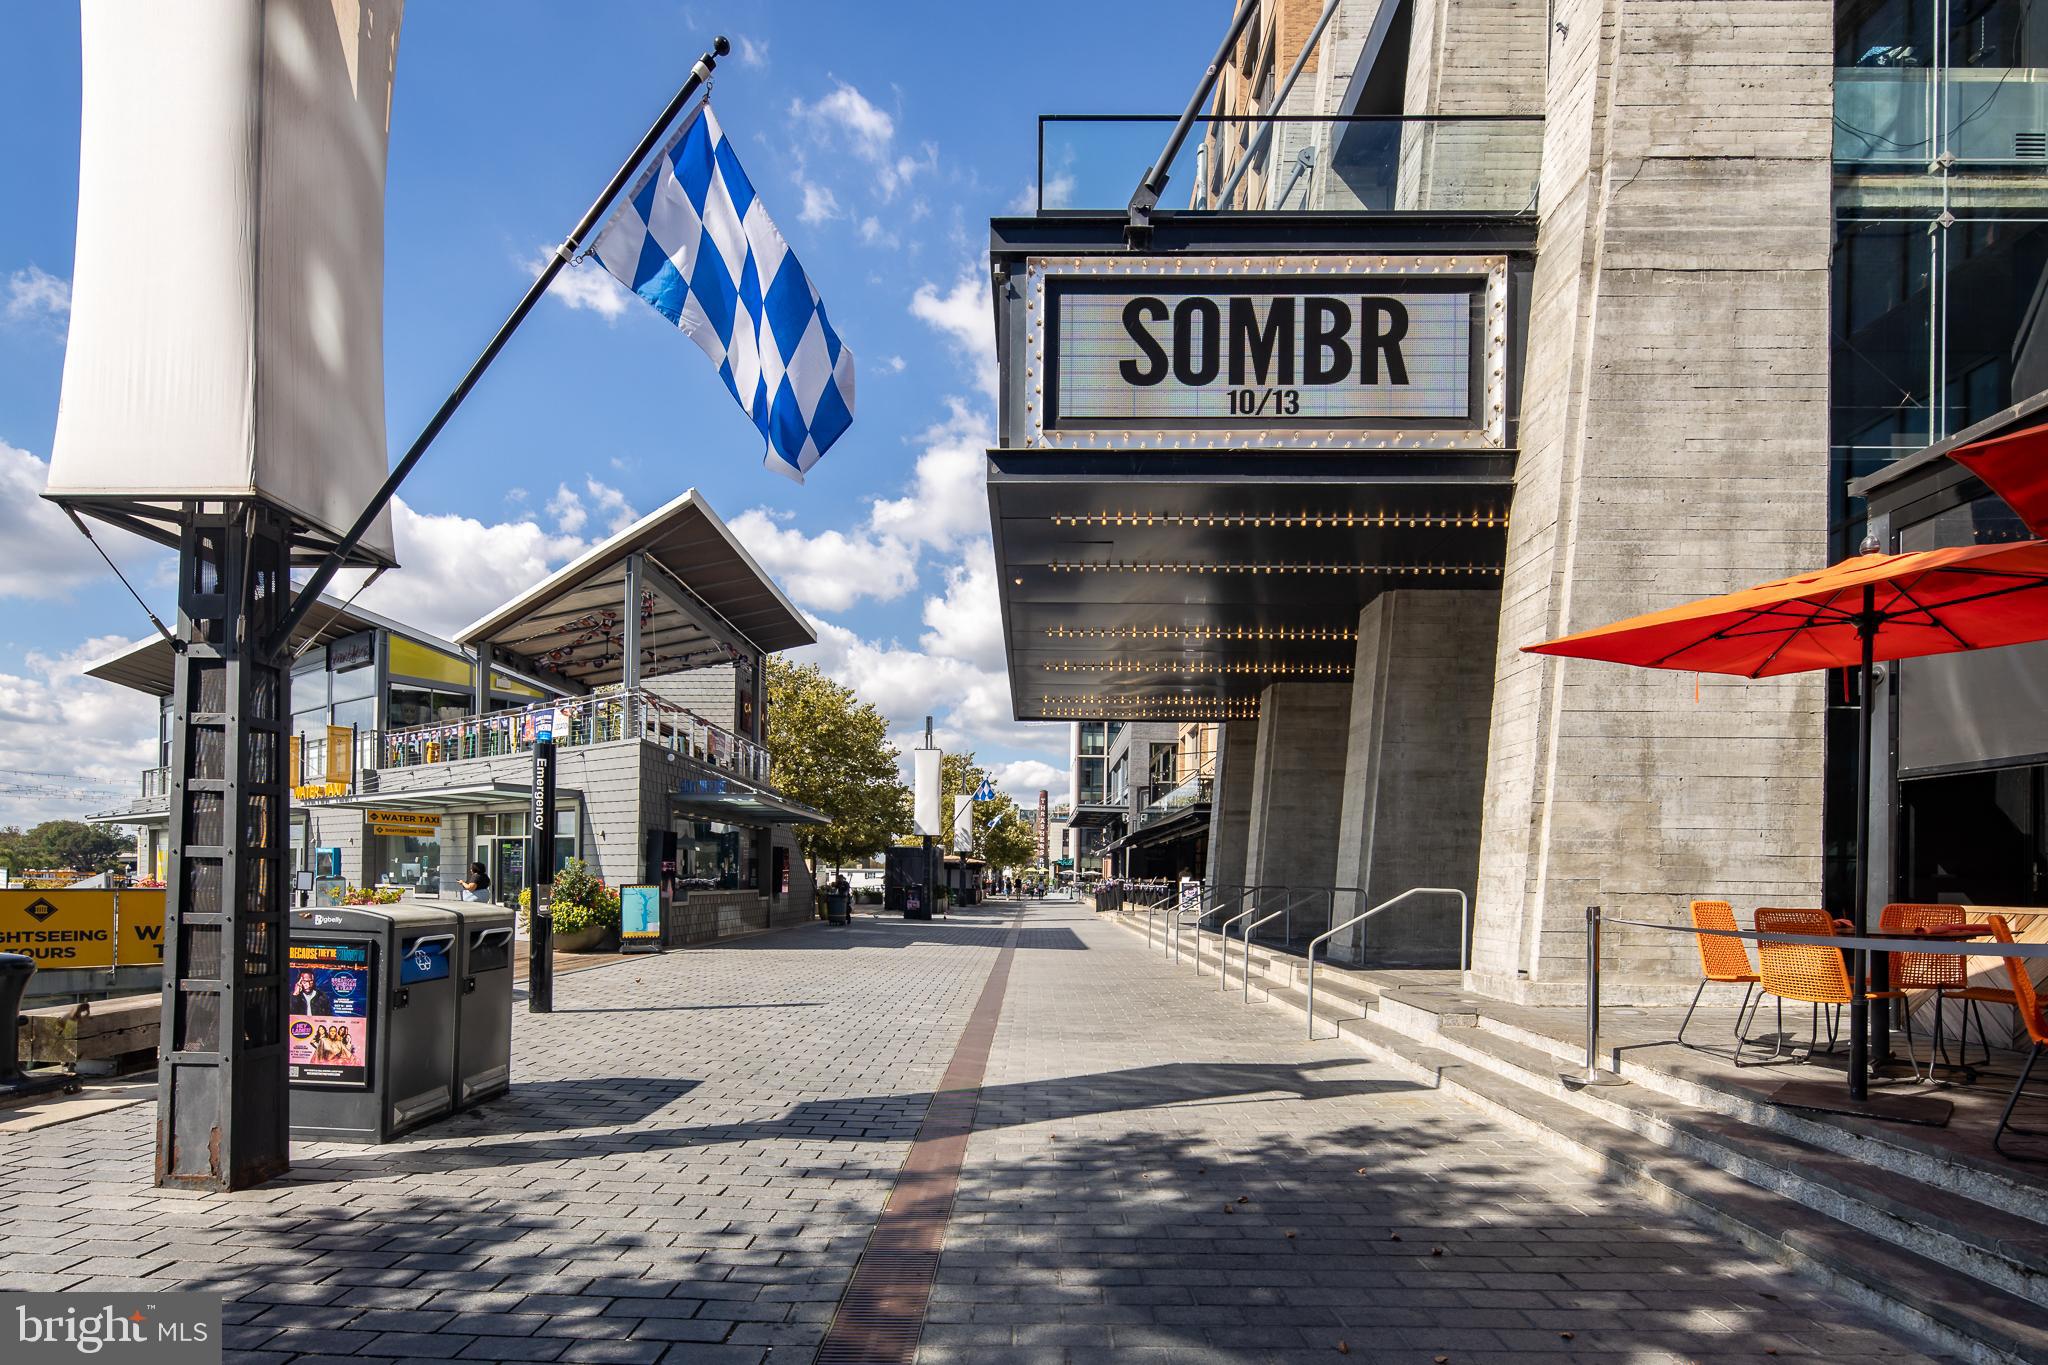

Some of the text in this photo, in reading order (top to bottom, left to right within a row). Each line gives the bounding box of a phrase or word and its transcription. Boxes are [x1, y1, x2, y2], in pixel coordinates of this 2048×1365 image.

[1119, 296, 1410, 387] SOMBR
[1227, 389, 1300, 416] 10/13
[295, 785, 320, 800] WATER
[533, 757, 547, 831] Emergency
[381, 813, 440, 824] WATER TAXI
